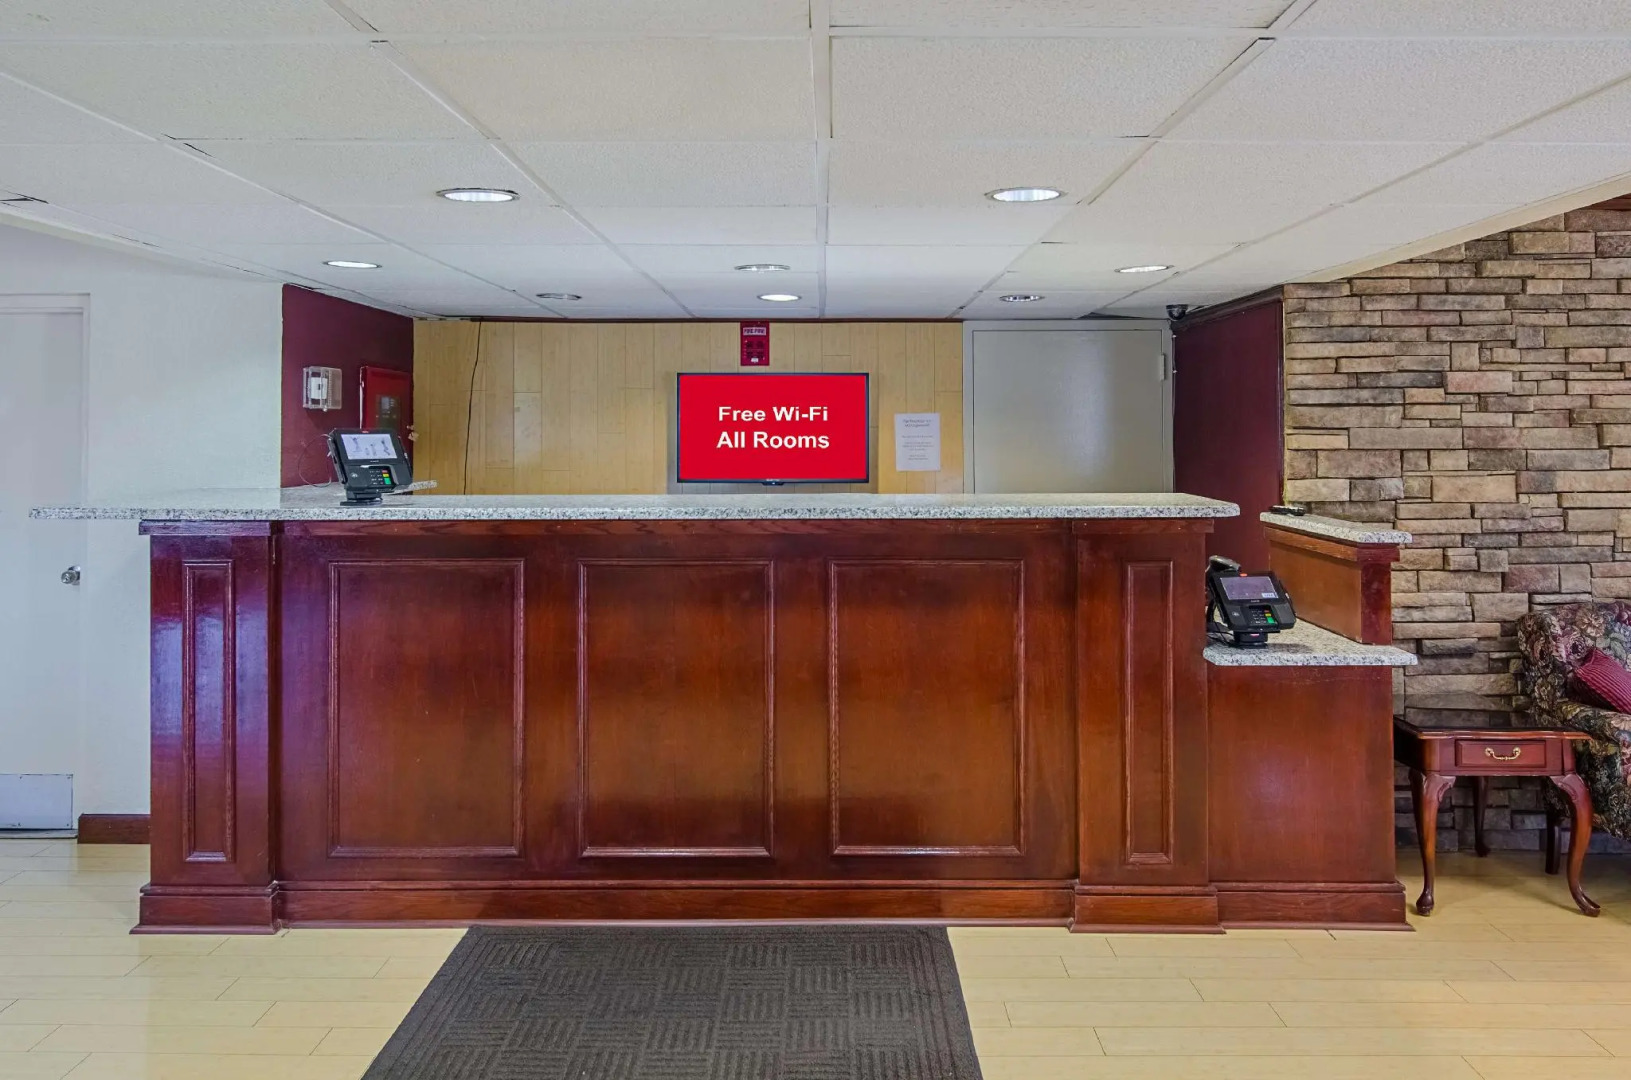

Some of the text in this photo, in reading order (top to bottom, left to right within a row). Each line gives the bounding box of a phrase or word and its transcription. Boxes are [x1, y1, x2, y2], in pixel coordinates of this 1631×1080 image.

[718, 406, 828, 422] Free Wi-Fi
[716, 431, 830, 449] All Rooms
